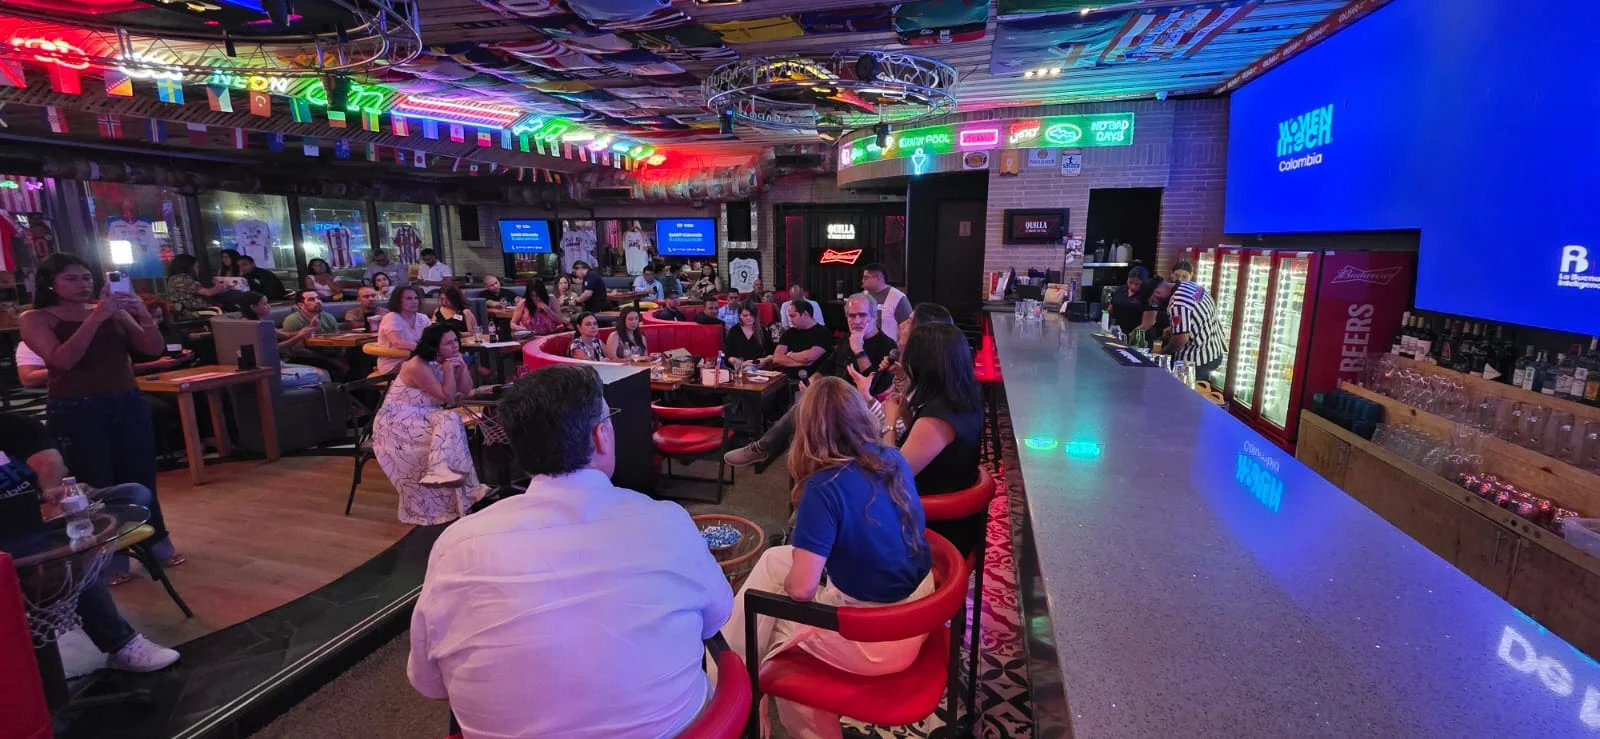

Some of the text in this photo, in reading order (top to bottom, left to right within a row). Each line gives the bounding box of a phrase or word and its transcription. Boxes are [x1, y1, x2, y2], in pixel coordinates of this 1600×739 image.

[1096, 131, 1124, 142] DAYS
[1279, 152, 1322, 172] Colombia
[741, 270, 748, 283] 9
[1340, 304, 1374, 372] BEERS
